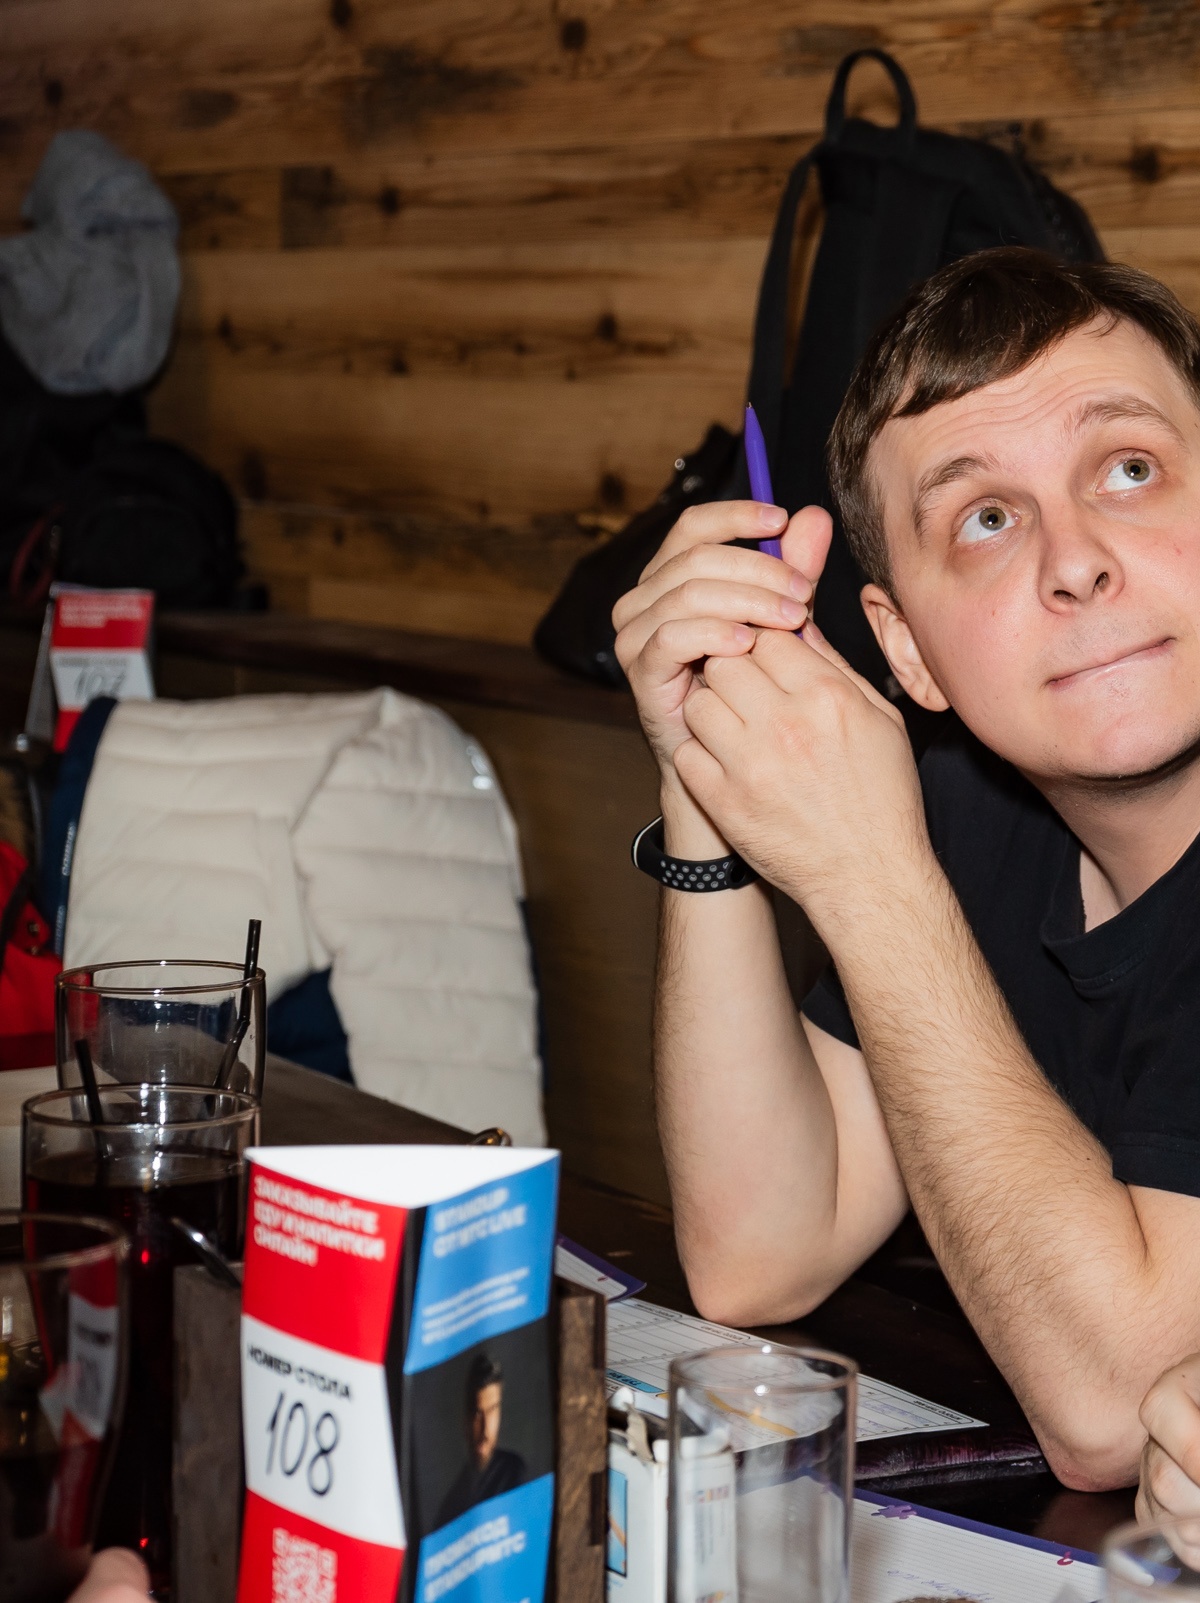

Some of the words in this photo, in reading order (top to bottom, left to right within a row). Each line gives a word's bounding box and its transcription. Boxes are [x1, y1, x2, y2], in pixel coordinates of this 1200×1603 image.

[254, 1175, 379, 1235] ЗАКАЗЫВАЙТЕ
[254, 1223, 318, 1267] ОНЛАЙН
[295, 1215, 386, 1261] НАПИТКИ
[247, 1344, 293, 1376] НОМЕР
[295, 1366, 352, 1401] СТОЛА
[266, 1390, 341, 1496] 108
